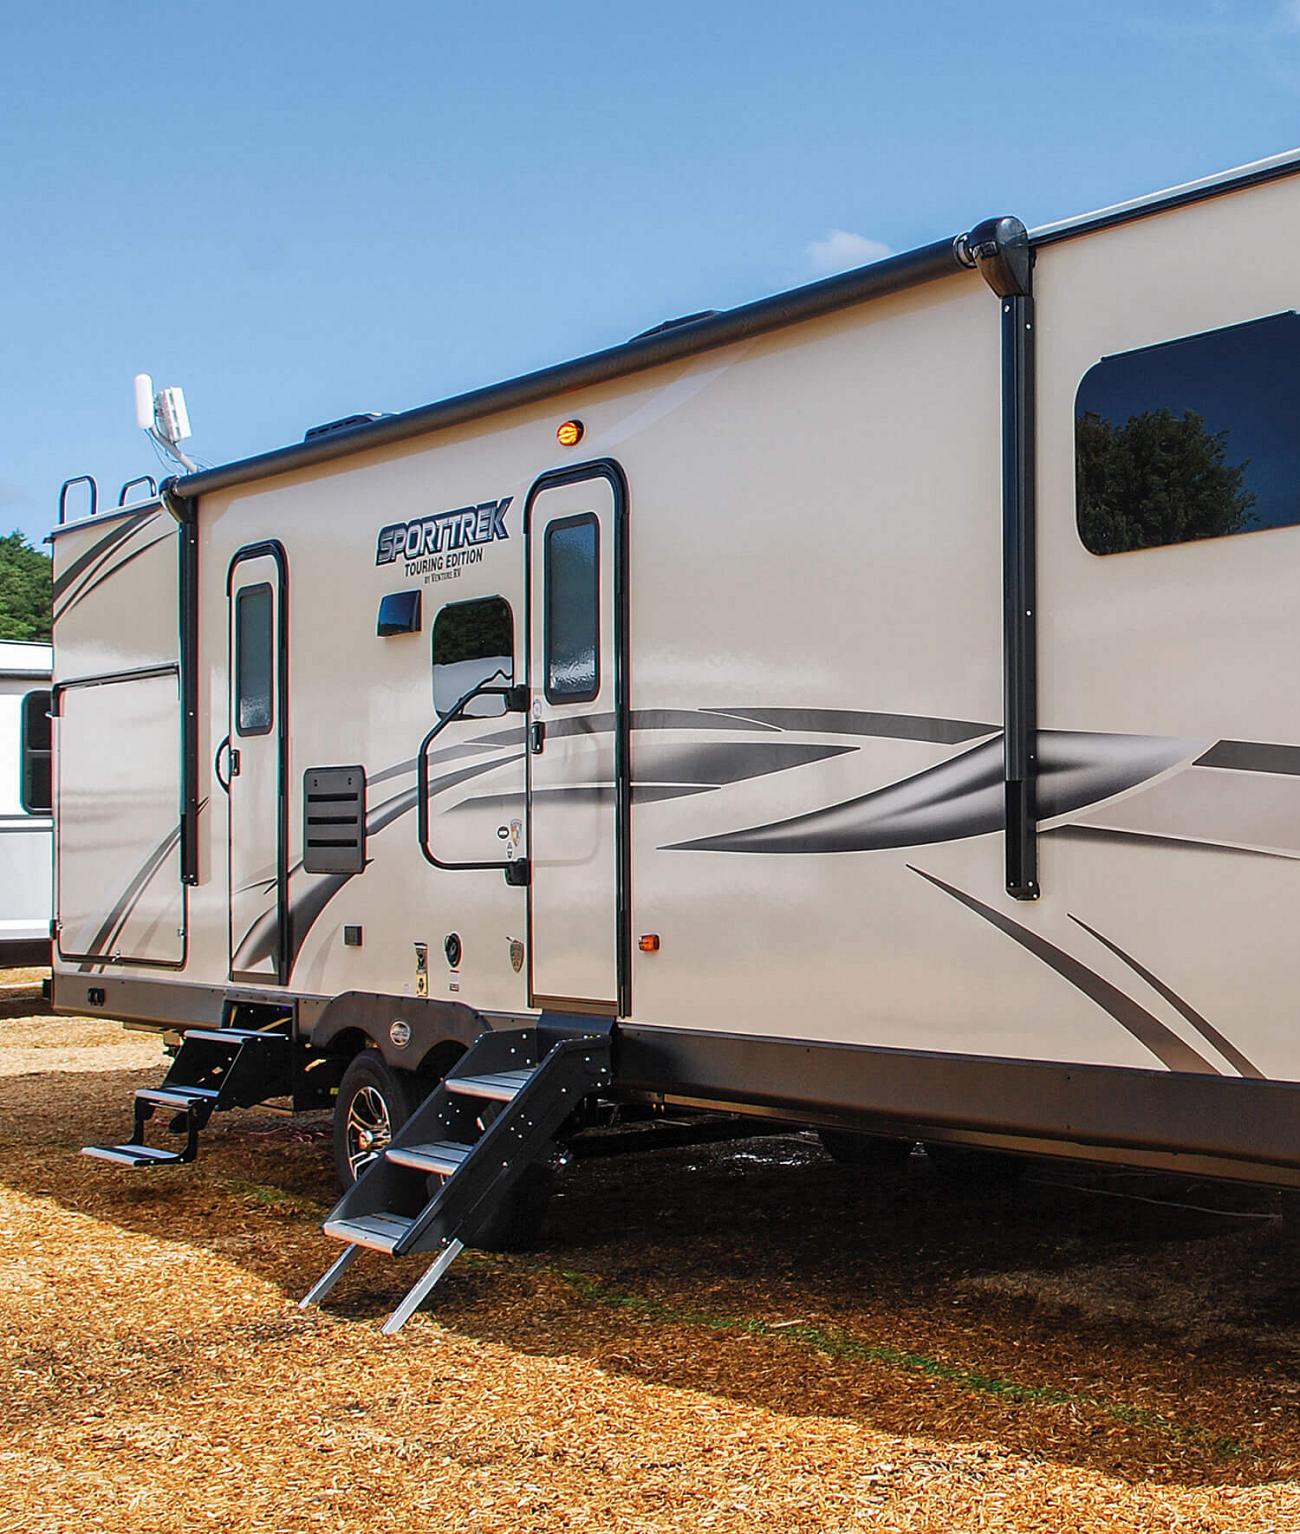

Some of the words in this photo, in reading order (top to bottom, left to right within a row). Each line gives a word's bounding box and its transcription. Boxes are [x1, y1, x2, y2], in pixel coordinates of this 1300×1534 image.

[376, 496, 514, 566] SPORTTREK
[404, 556, 443, 577] TOURING
[446, 548, 483, 568] EDITION
